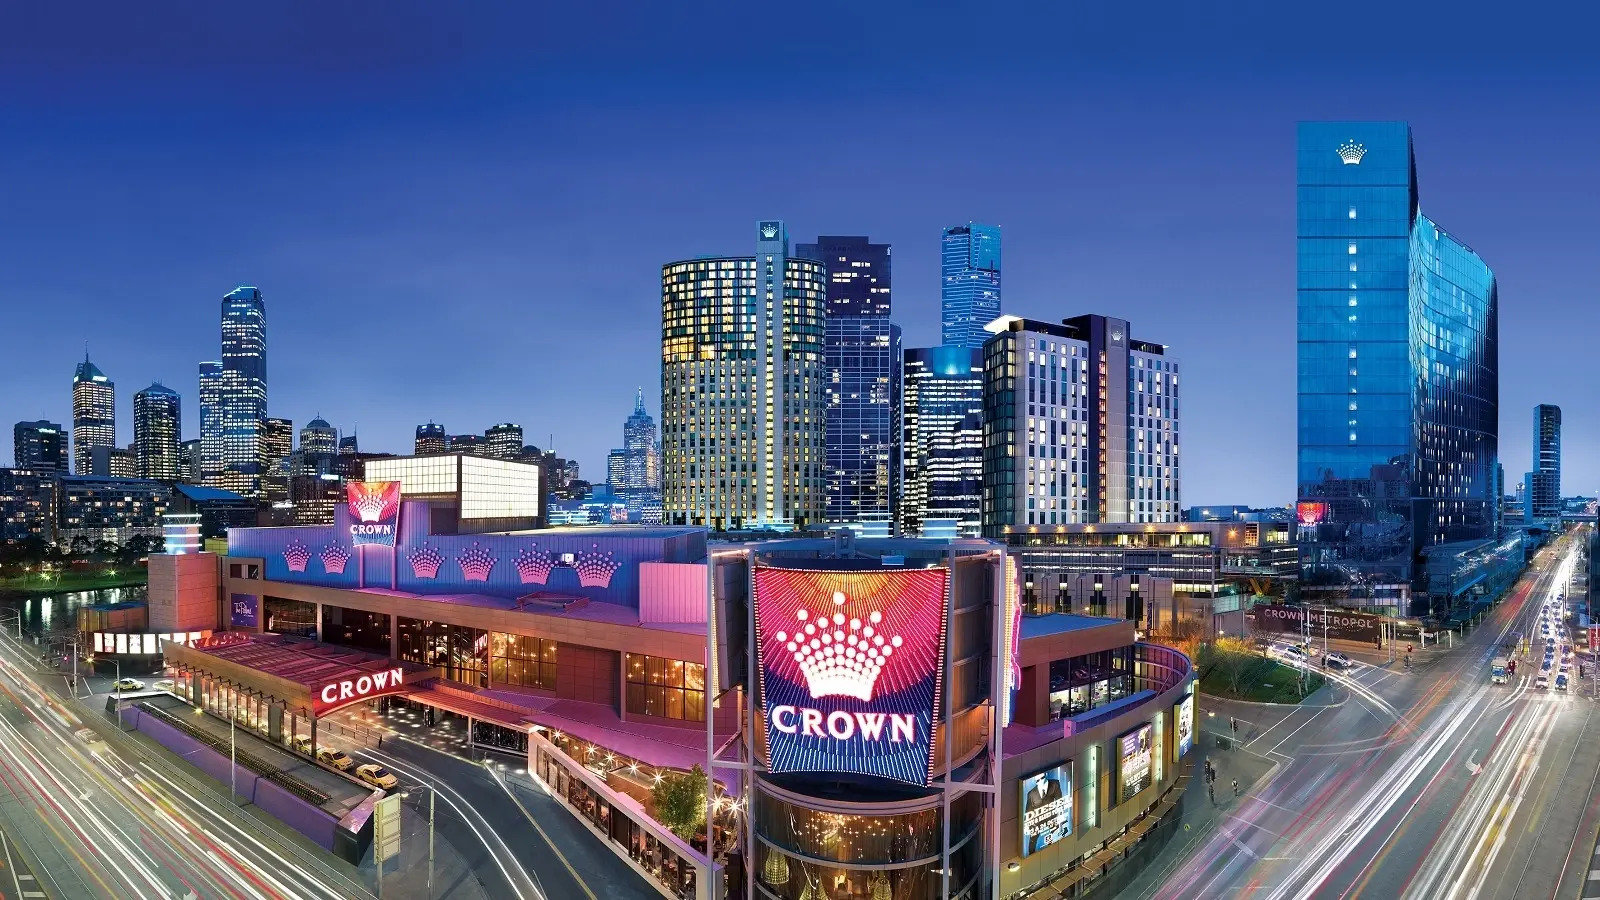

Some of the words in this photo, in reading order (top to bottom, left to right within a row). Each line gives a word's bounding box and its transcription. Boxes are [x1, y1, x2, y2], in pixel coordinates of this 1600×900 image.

[350, 524, 391, 535] CROWN
[1264, 608, 1305, 621] CROWN
[1310, 613, 1374, 629] METROPOL
[321, 668, 403, 703] CROWN
[771, 704, 917, 744] CROWN
